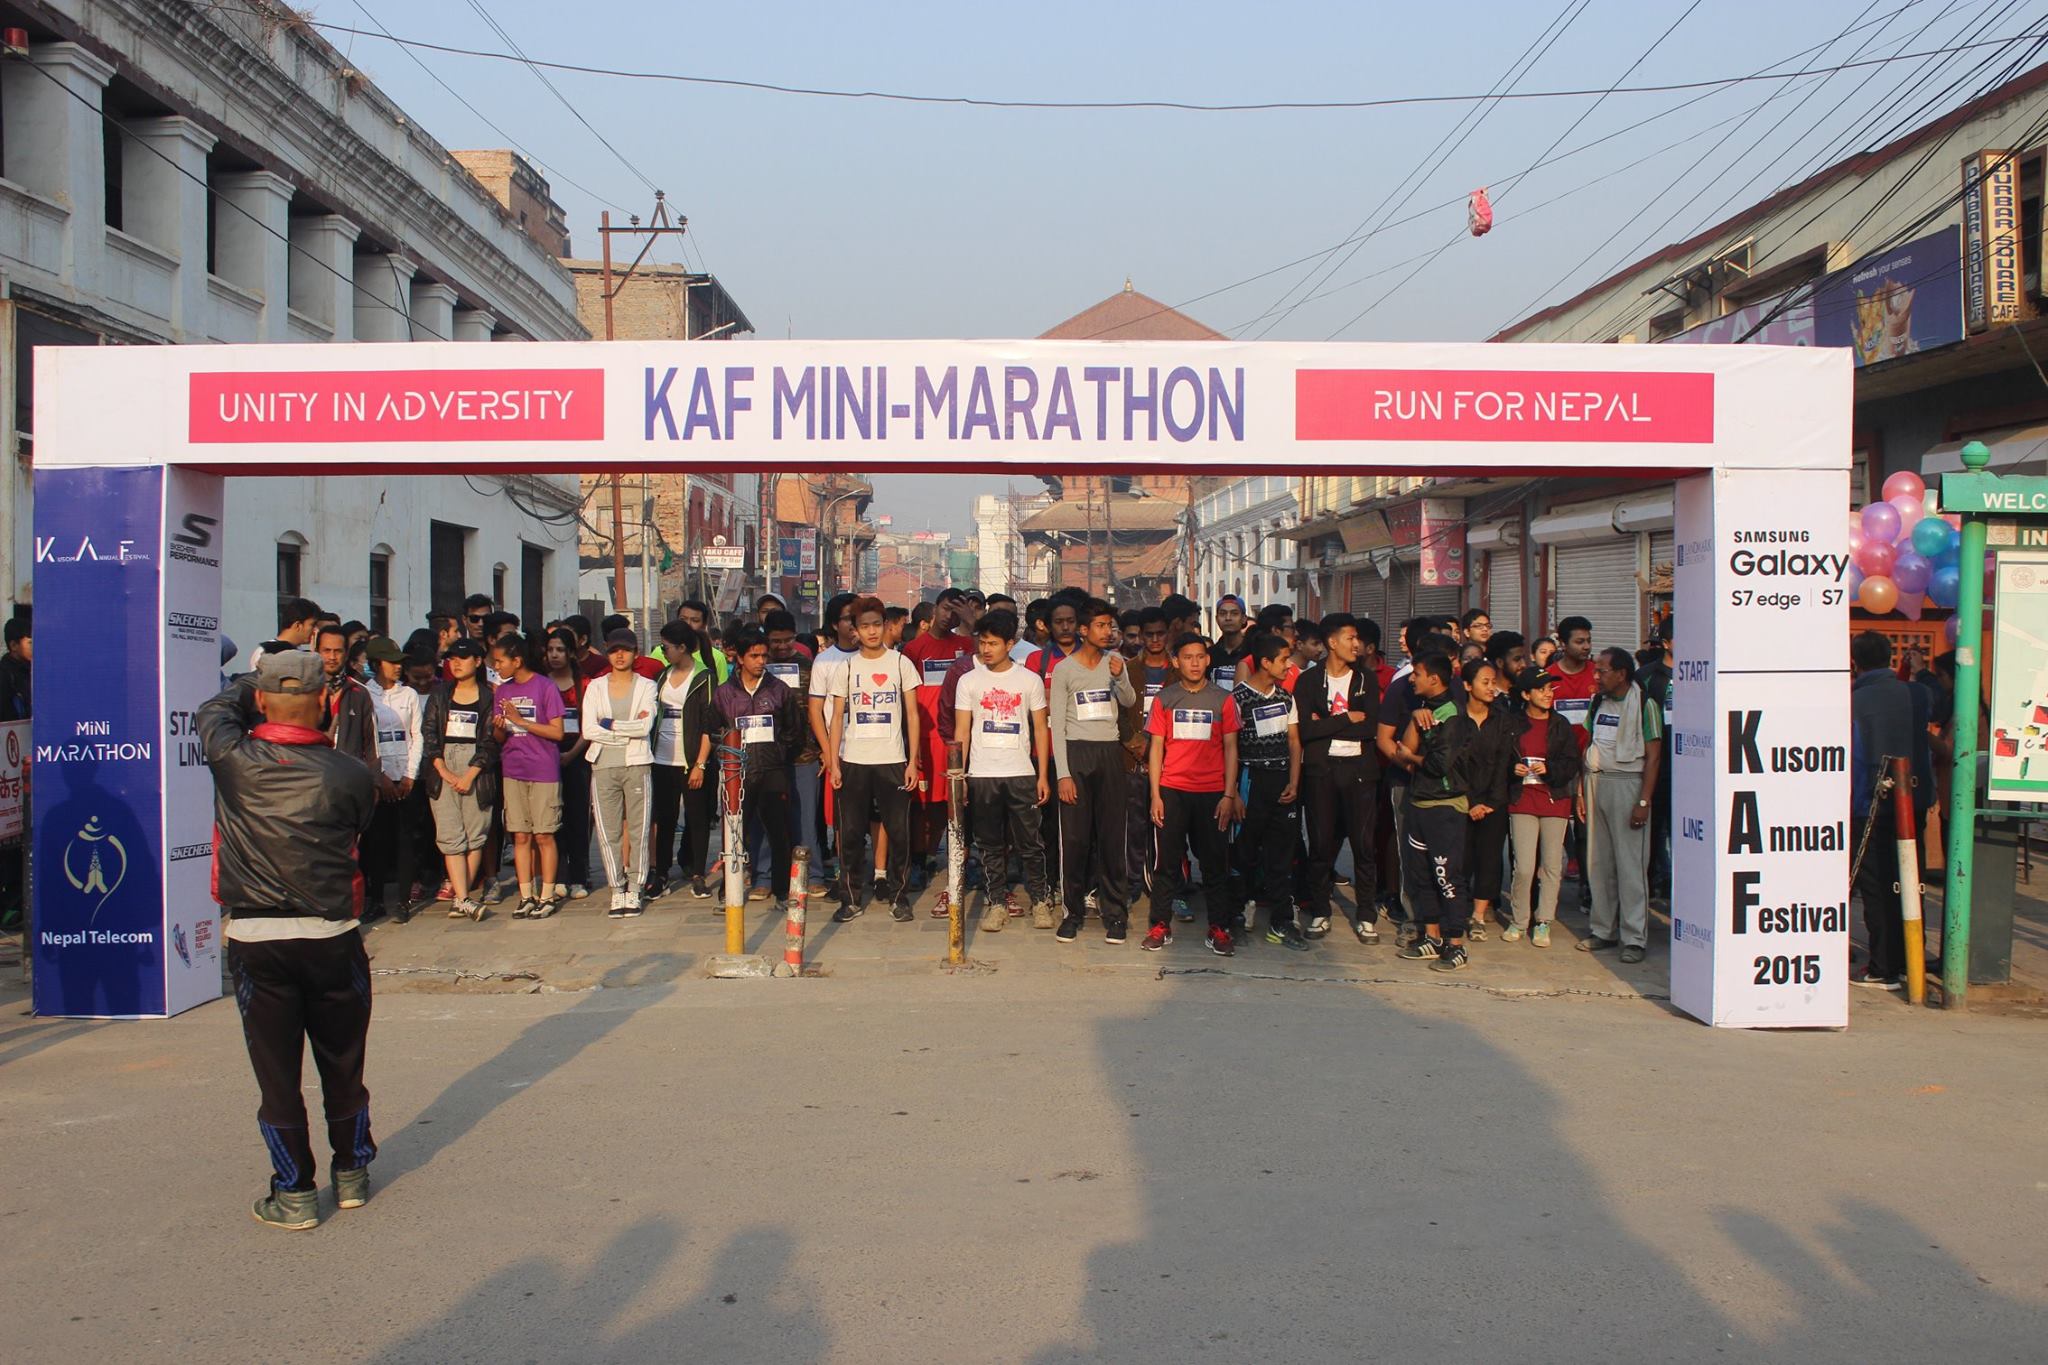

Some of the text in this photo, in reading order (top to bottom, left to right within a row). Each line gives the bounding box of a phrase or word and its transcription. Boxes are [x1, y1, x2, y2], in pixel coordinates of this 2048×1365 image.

[1995, 235, 2016, 302] SQUARE
[1991, 304, 2020, 319] CAFE
[219, 391, 574, 422] UNITY IN ADVERSITY
[644, 365, 1245, 443] KAF MINI-MARATHON
[1374, 390, 1652, 422] RUN FOR NEPAL
[1734, 530, 1810, 543] SAMSUNG
[169, 550, 219, 568] PERFORMANCE
[723, 548, 743, 556] CAFE
[1730, 549, 1850, 582] Galaxy
[1731, 589, 1844, 610] S7 edge S7
[169, 612, 217, 630] SKECHERS
[1678, 660, 1710, 681] START
[37, 743, 151, 763] MARATHON
[1683, 816, 1704, 841] LINE
[41, 930, 153, 948] Nepal Telecom
[1753, 955, 1821, 985] 2015
